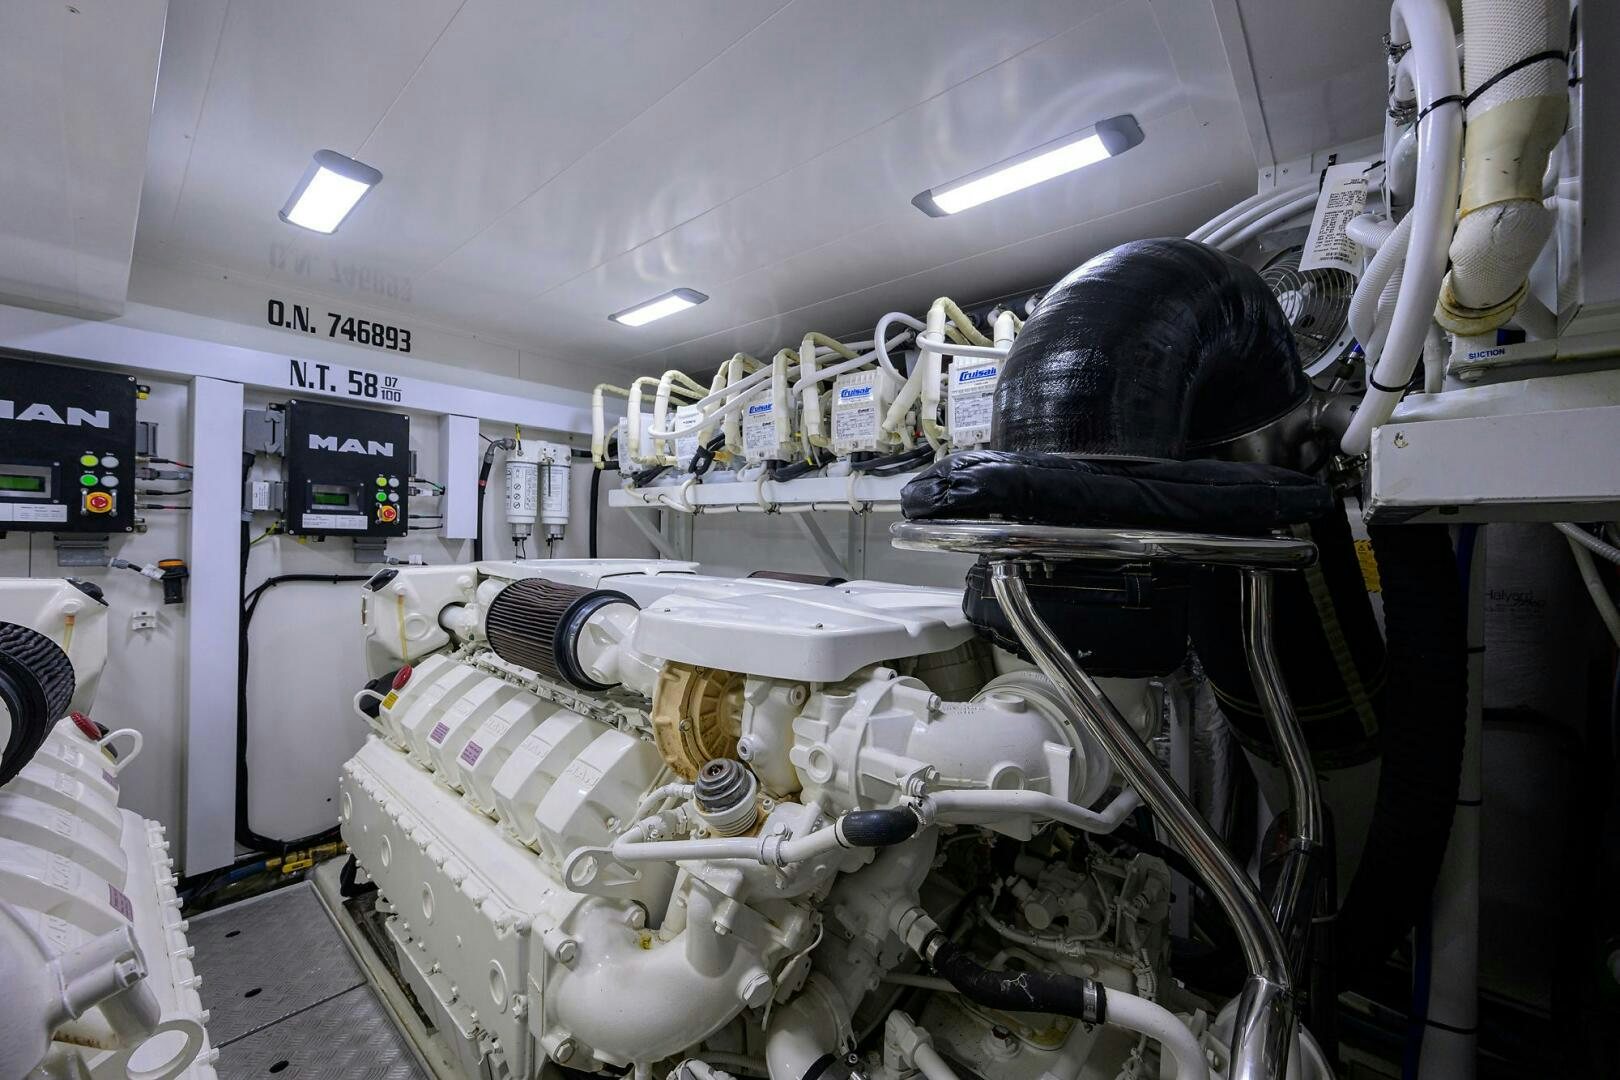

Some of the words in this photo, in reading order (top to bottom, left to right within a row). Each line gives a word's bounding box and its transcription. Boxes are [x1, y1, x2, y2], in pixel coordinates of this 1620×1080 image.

[268, 299, 316, 334] O.N.
[327, 312, 411, 353] 746893
[1468, 347, 1505, 360] SUCTION
[290, 359, 336, 392] N.T.
[348, 369, 378, 398] 58
[384, 376, 399, 388] 07
[380, 389, 402, 402] 100
[841, 386, 872, 398] Cruisair
[308, 433, 394, 457] MAN
